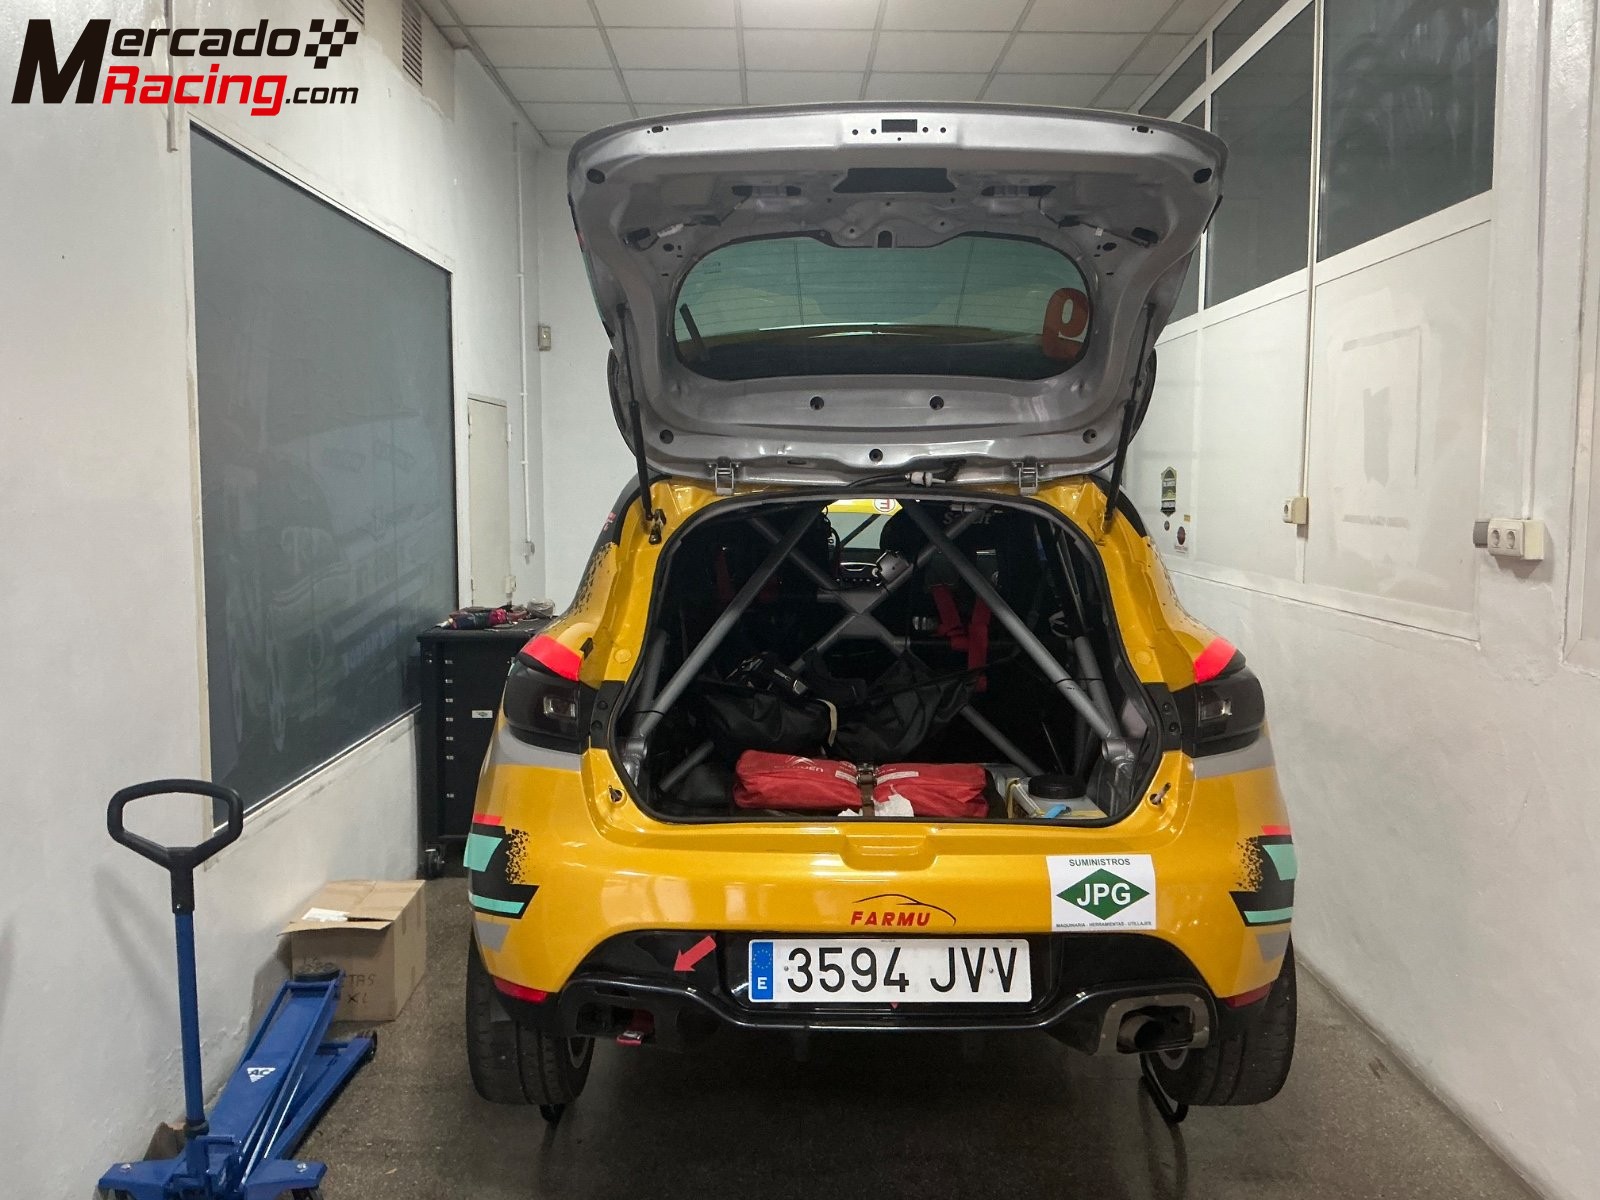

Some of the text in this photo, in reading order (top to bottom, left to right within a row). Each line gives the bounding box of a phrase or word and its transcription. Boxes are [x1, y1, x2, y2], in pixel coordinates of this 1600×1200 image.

[1069, 858, 1131, 867] SUMINISTROS
[1076, 882, 1131, 907] JPG
[850, 911, 931, 927] FARMU
[787, 946, 1018, 993] 3594 JVV
[757, 976, 768, 990] E
